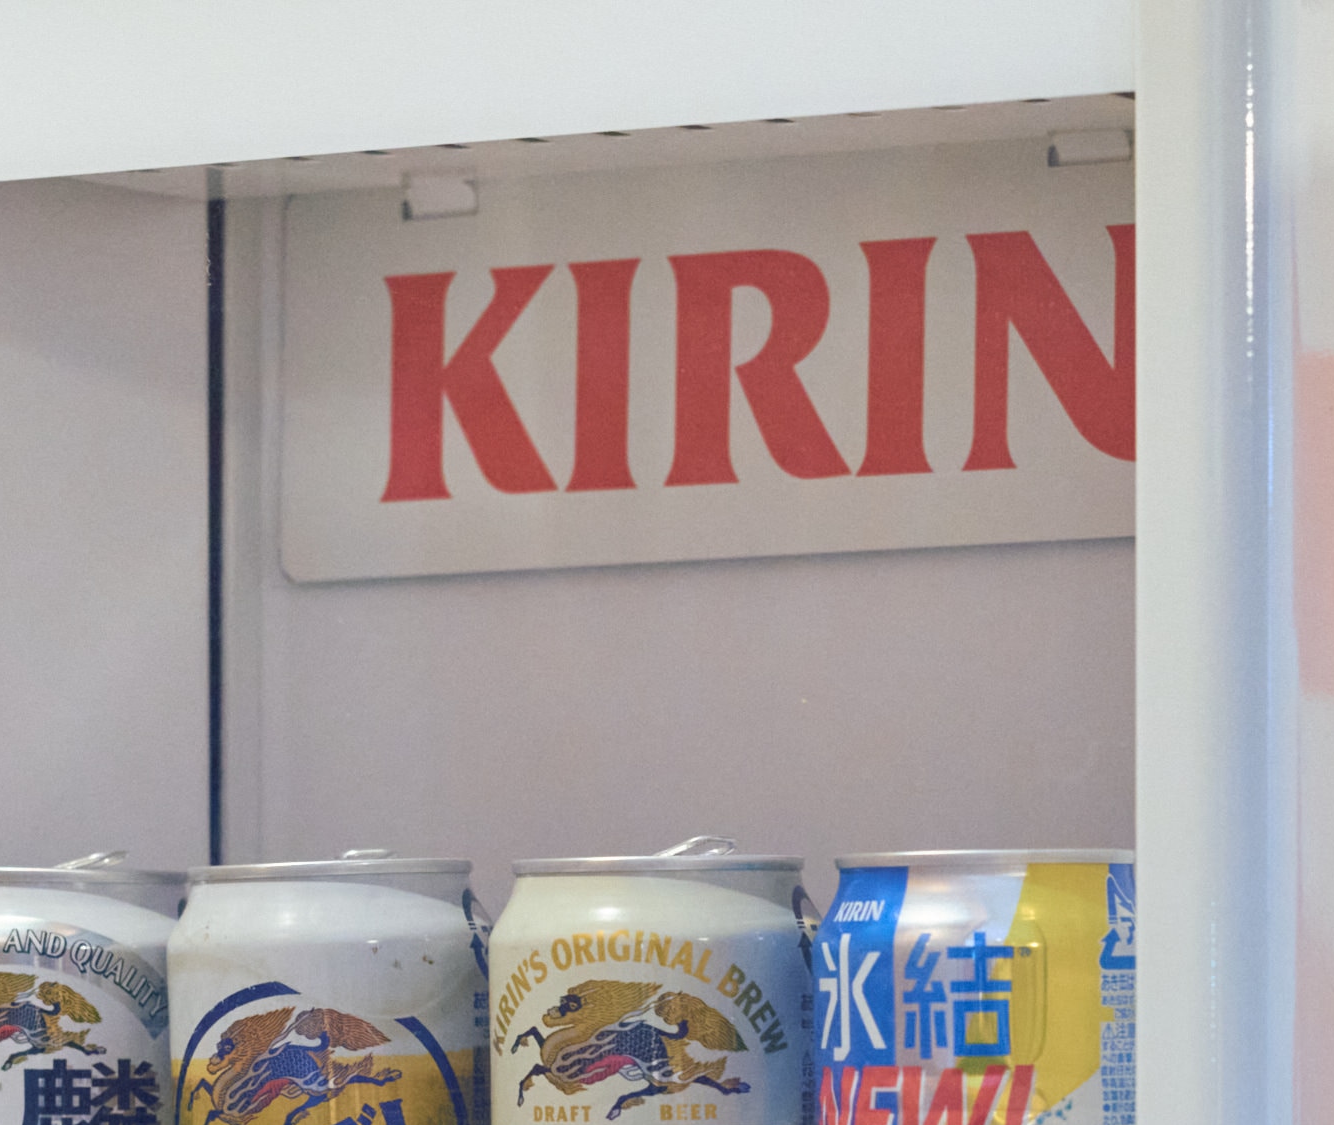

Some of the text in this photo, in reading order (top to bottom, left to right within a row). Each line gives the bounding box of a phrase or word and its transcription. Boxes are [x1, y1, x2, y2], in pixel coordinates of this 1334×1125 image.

[380, 223, 1135, 502] KIRIN
[833, 900, 884, 922] KIRIN
[3, 928, 66, 957] AND
[71, 939, 167, 1017] QUALITY
[493, 929, 788, 1057] KIRIN'S ORIGINAL BREW
[819, 932, 1014, 1061] 氷結
[533, 1103, 718, 1123] DRAFT BEER
